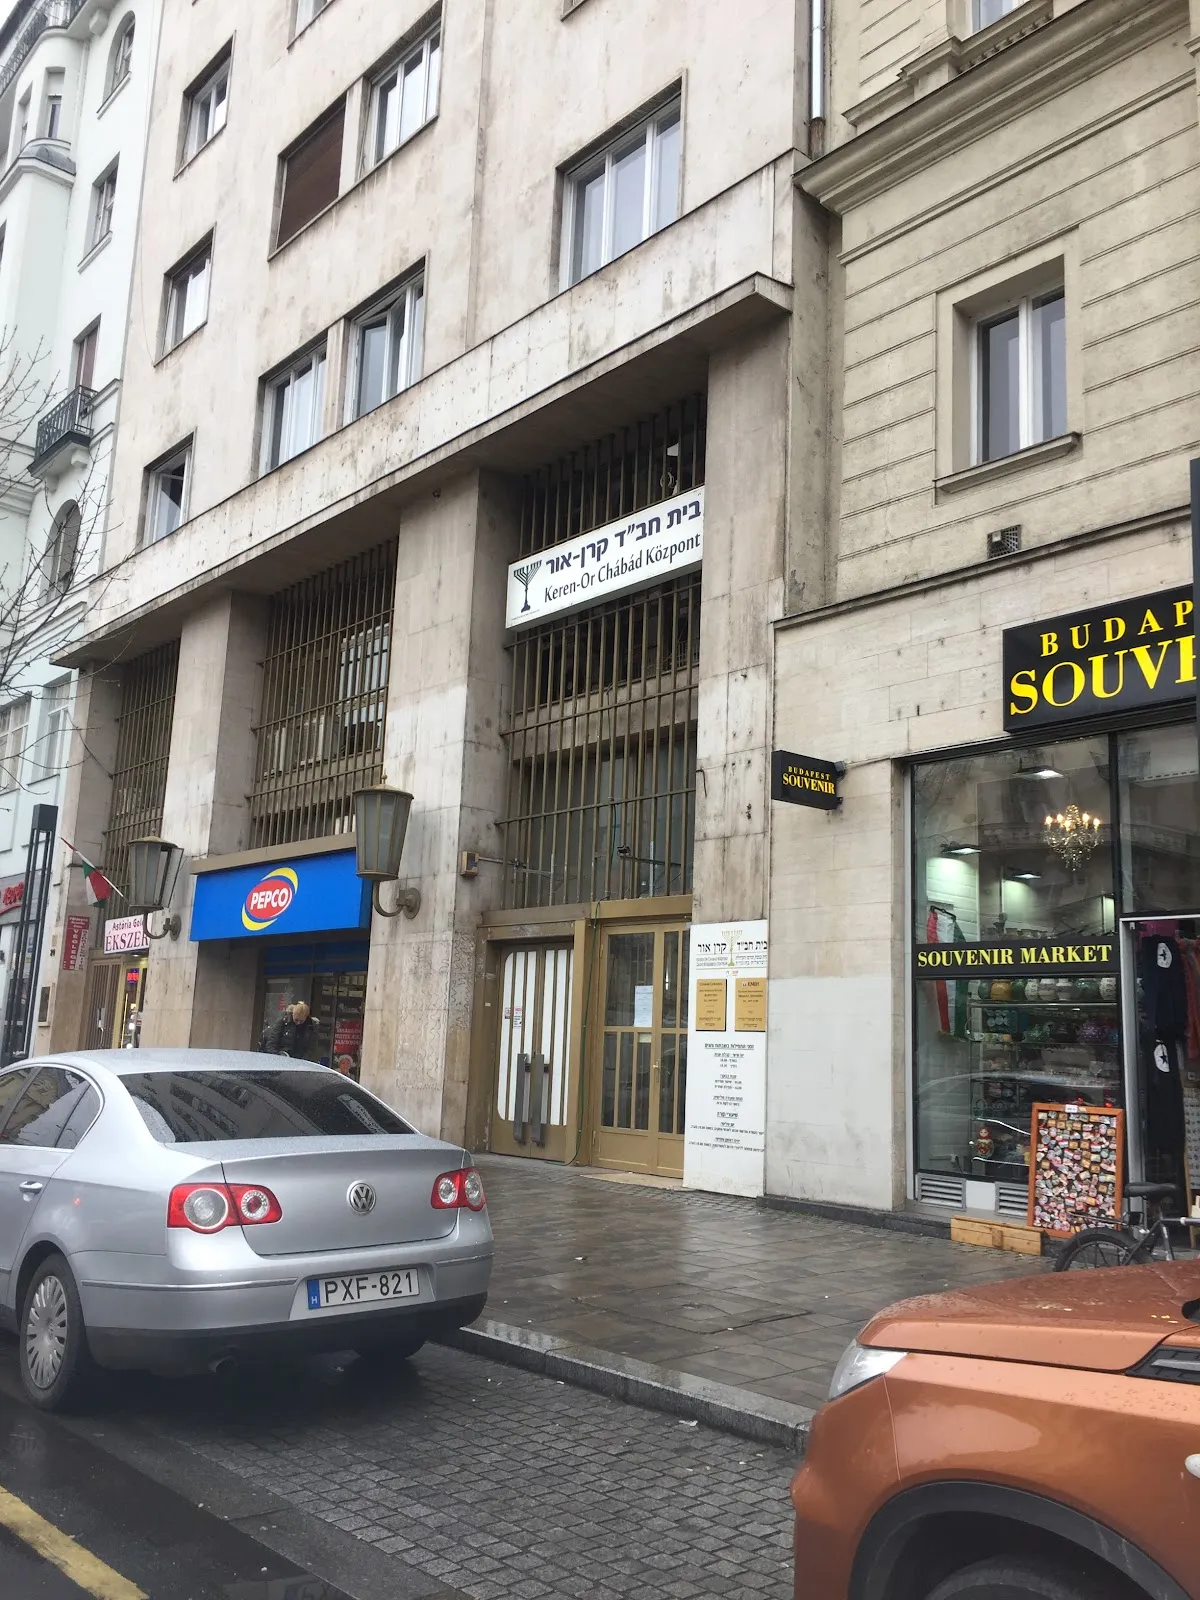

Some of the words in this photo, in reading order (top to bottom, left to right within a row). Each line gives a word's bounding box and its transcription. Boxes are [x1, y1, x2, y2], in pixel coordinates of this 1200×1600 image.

[666, 500, 702, 529] בית
[545, 537, 609, 574] קרן-אור
[544, 572, 596, 603] Keren-Or
[598, 549, 643, 582] Chábád
[646, 533, 701, 565] Központ
[782, 772, 836, 795] SOUVENIR
[788, 765, 831, 781] BUDAPEST
[250, 887, 289, 911] PEPCO
[133, 917, 144, 927] Gol
[917, 948, 1015, 968] SOUVENIR
[1020, 944, 1112, 964] MARKET
[311, 1295, 318, 1305] H
[324, 1271, 413, 1303] PXF-821
